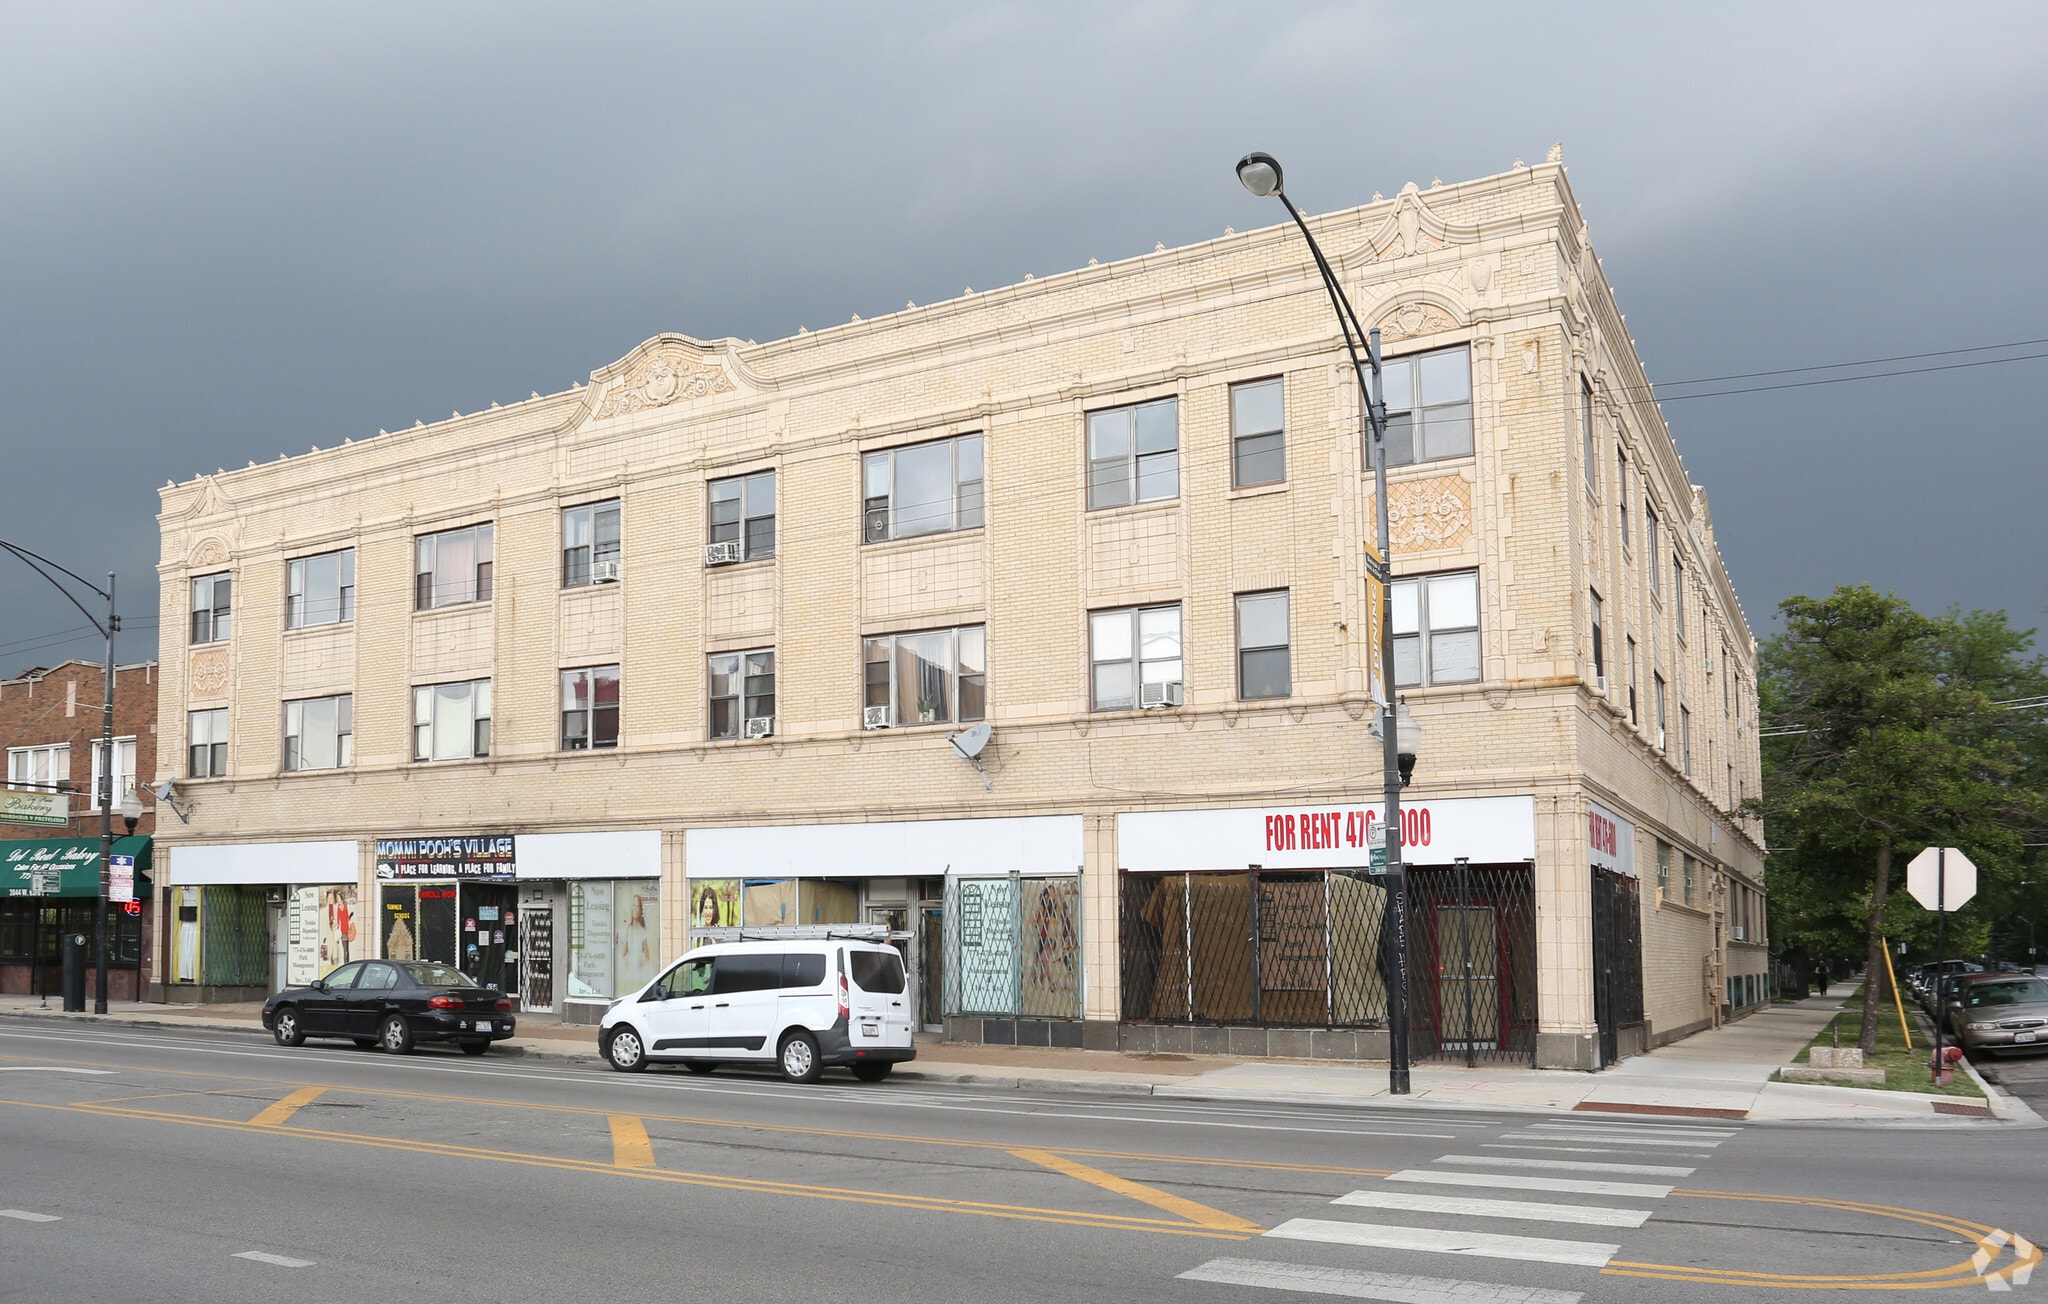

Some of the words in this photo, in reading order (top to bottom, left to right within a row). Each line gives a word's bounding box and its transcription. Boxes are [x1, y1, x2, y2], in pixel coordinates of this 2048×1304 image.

[4, 797, 52, 815] Bakery
[1266, 814, 1296, 852] FOR
[1300, 812, 1341, 850] RENT
[377, 840, 416, 859] MOMMI
[419, 839, 462, 858] POOH'S
[464, 838, 512, 858] VILLAGE
[6, 848, 31, 862] Del
[30, 847, 62, 862] Real
[60, 846, 100, 866] Bakery
[395, 864, 399, 874] A
[401, 864, 416, 874] PLACE
[418, 864, 428, 874] FOR
[458, 863, 463, 873] A
[464, 863, 481, 874] PLACE
[484, 863, 494, 873] FOR
[496, 862, 515, 874] FAMILY
[305, 891, 314, 899] Now
[592, 886, 604, 895] Now
[302, 904, 318, 912] Leasing
[586, 900, 610, 912] Leasing
